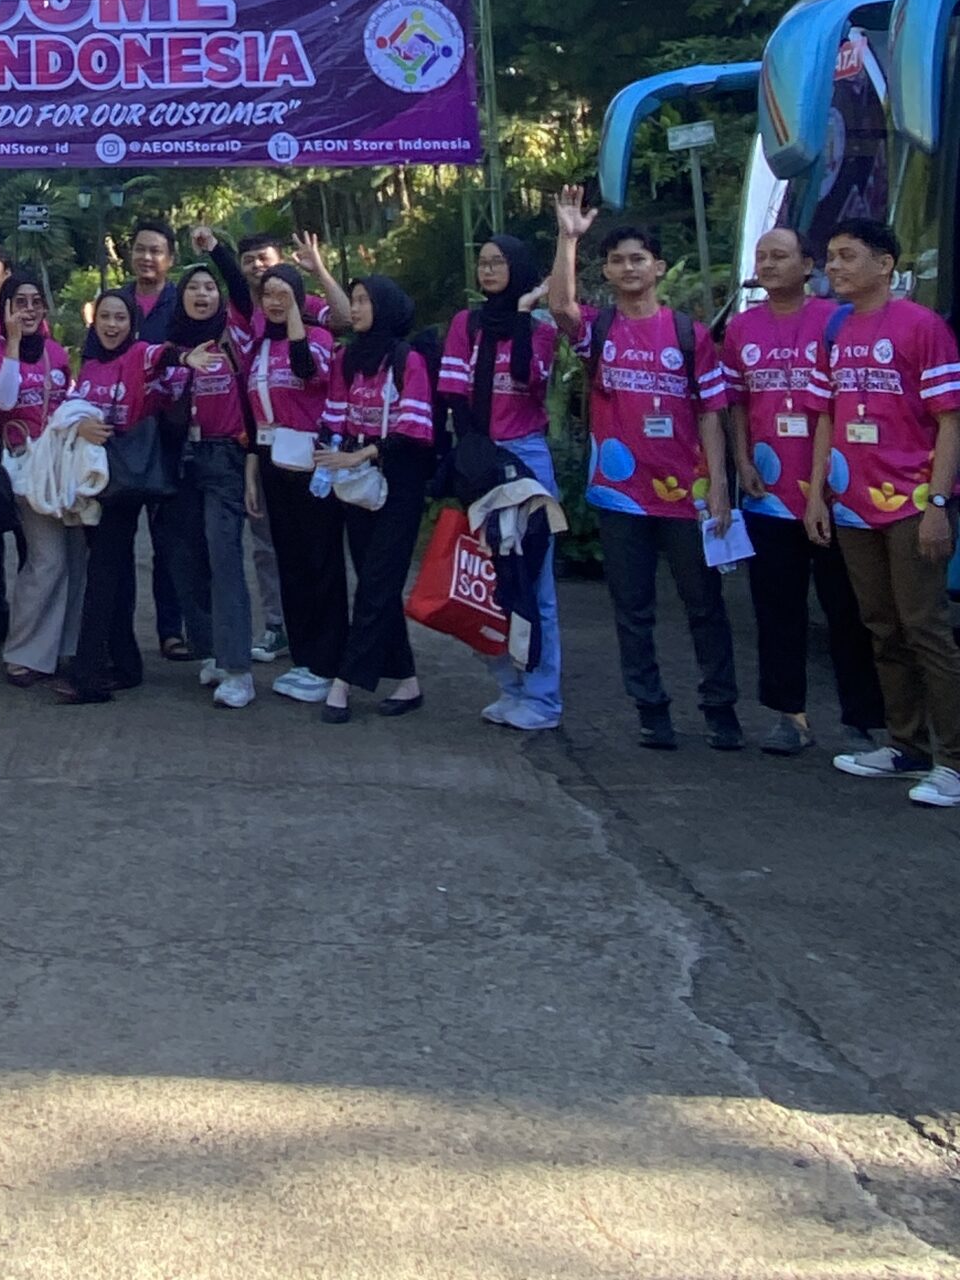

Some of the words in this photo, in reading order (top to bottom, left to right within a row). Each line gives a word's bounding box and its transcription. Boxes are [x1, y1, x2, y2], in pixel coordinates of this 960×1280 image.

[35, 103, 90, 128] FOR
[91, 102, 147, 127] OUR
[303, 139, 348, 152] AEON
[353, 139, 394, 151] Store
[399, 137, 471, 151] Indonesia
